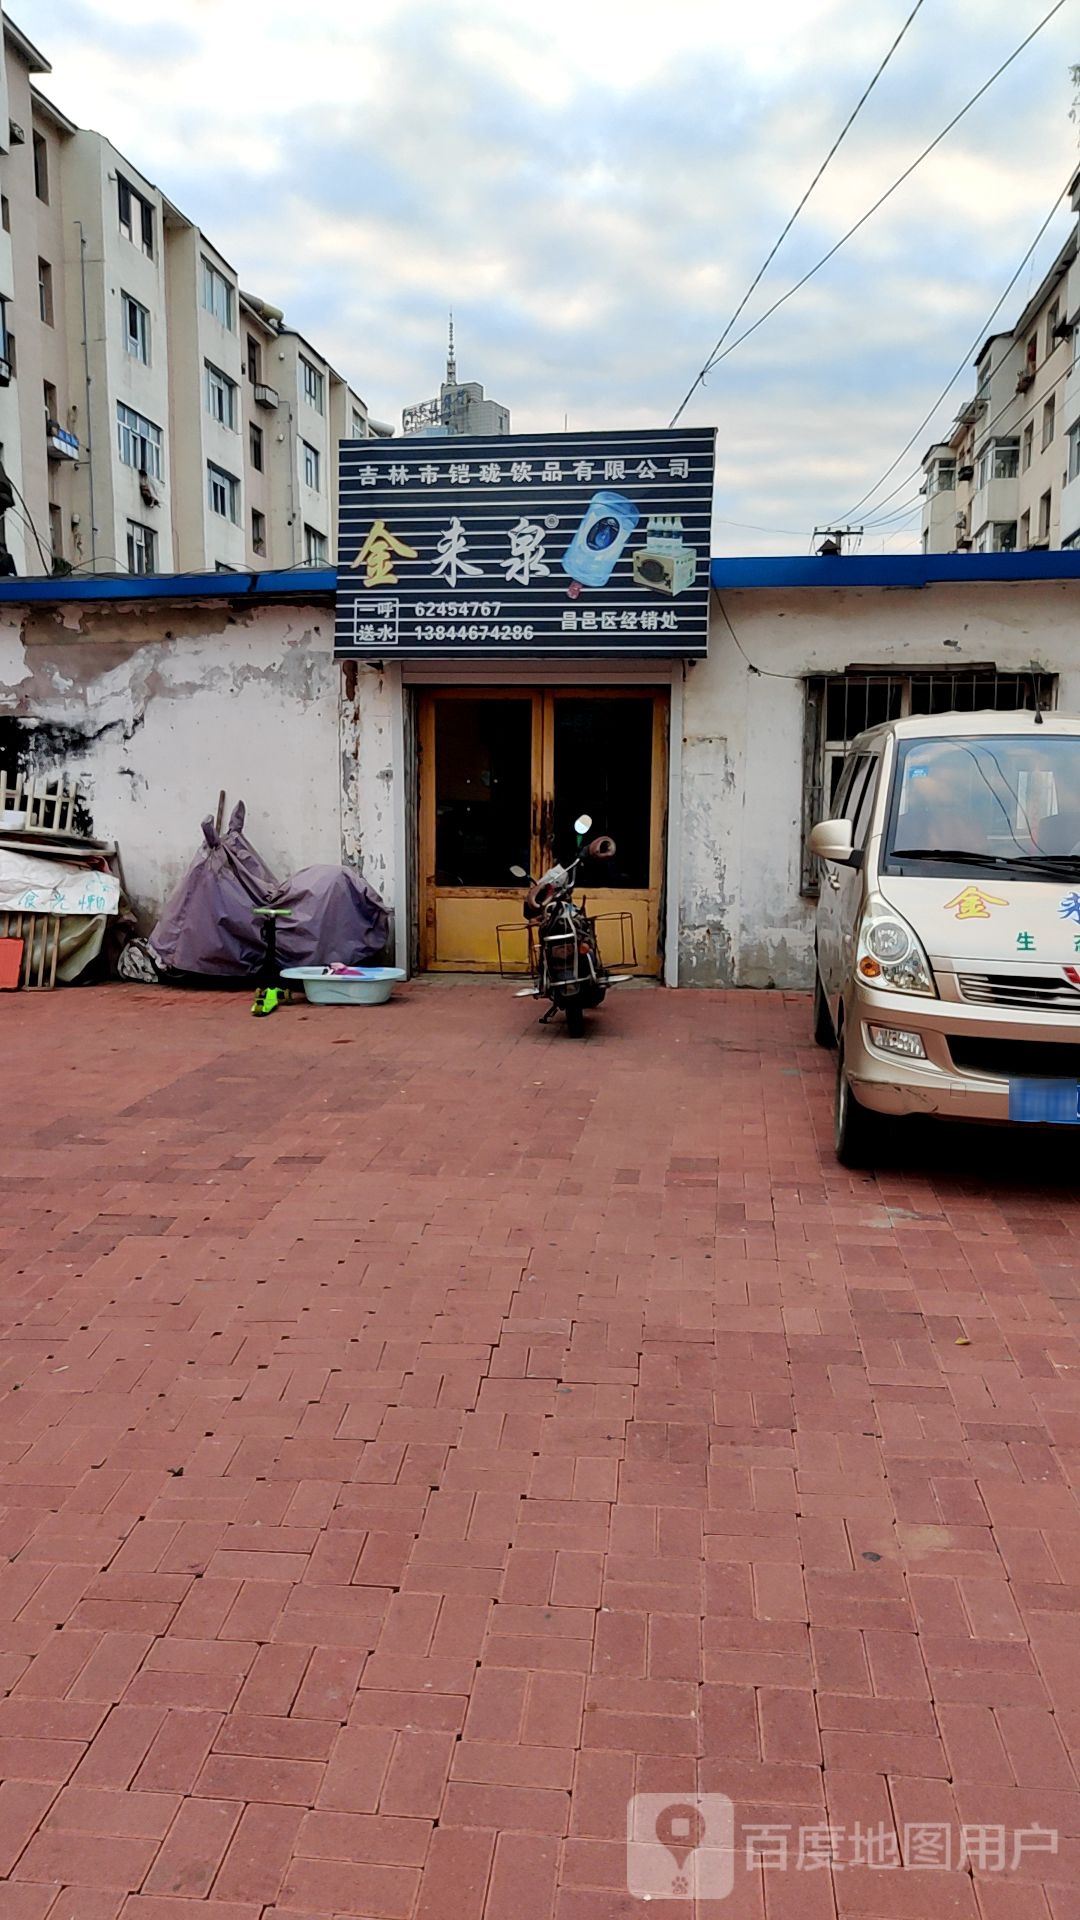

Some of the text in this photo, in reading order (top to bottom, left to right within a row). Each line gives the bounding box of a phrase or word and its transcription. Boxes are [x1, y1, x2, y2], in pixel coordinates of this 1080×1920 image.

[358, 458, 690, 487] 吉林市铠珑饮品有限公司
[350, 516, 551, 588] 金来泉
[358, 602, 394, 619] 一呼
[414, 601, 501, 617] 62454767
[561, 610, 679, 631] 昌邑区经销处
[358, 624, 394, 642] 送水
[414, 625, 534, 641] 13844674286
